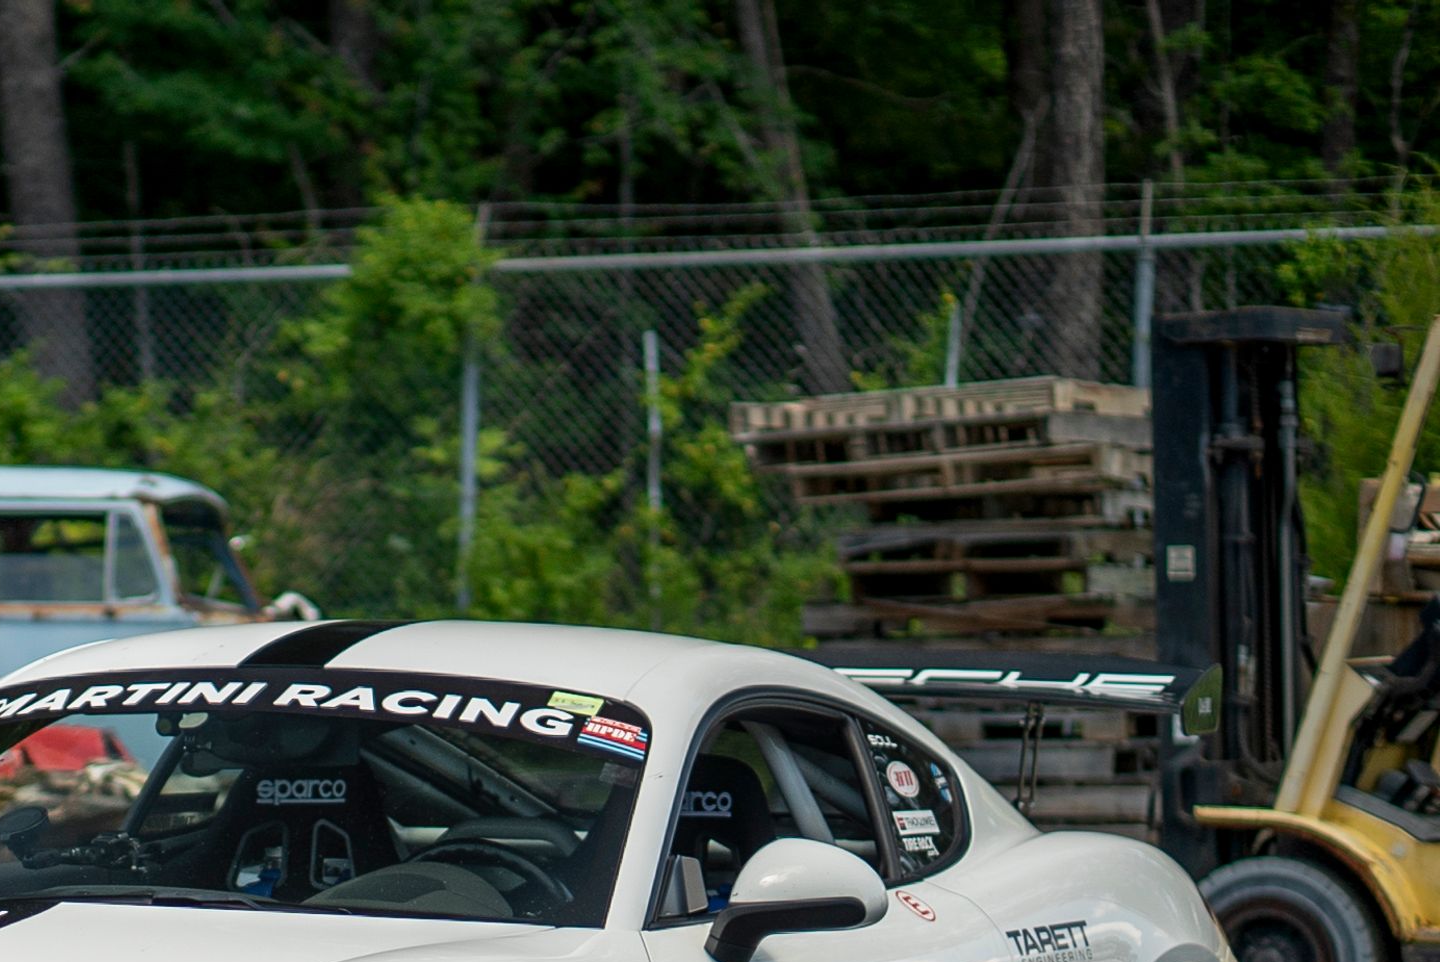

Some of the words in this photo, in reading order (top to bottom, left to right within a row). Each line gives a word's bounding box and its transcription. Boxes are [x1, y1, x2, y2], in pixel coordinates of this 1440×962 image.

[272, 683, 575, 737] RACING
[256, 779, 346, 805] sparco
[1005, 920, 1090, 956] TARETT
